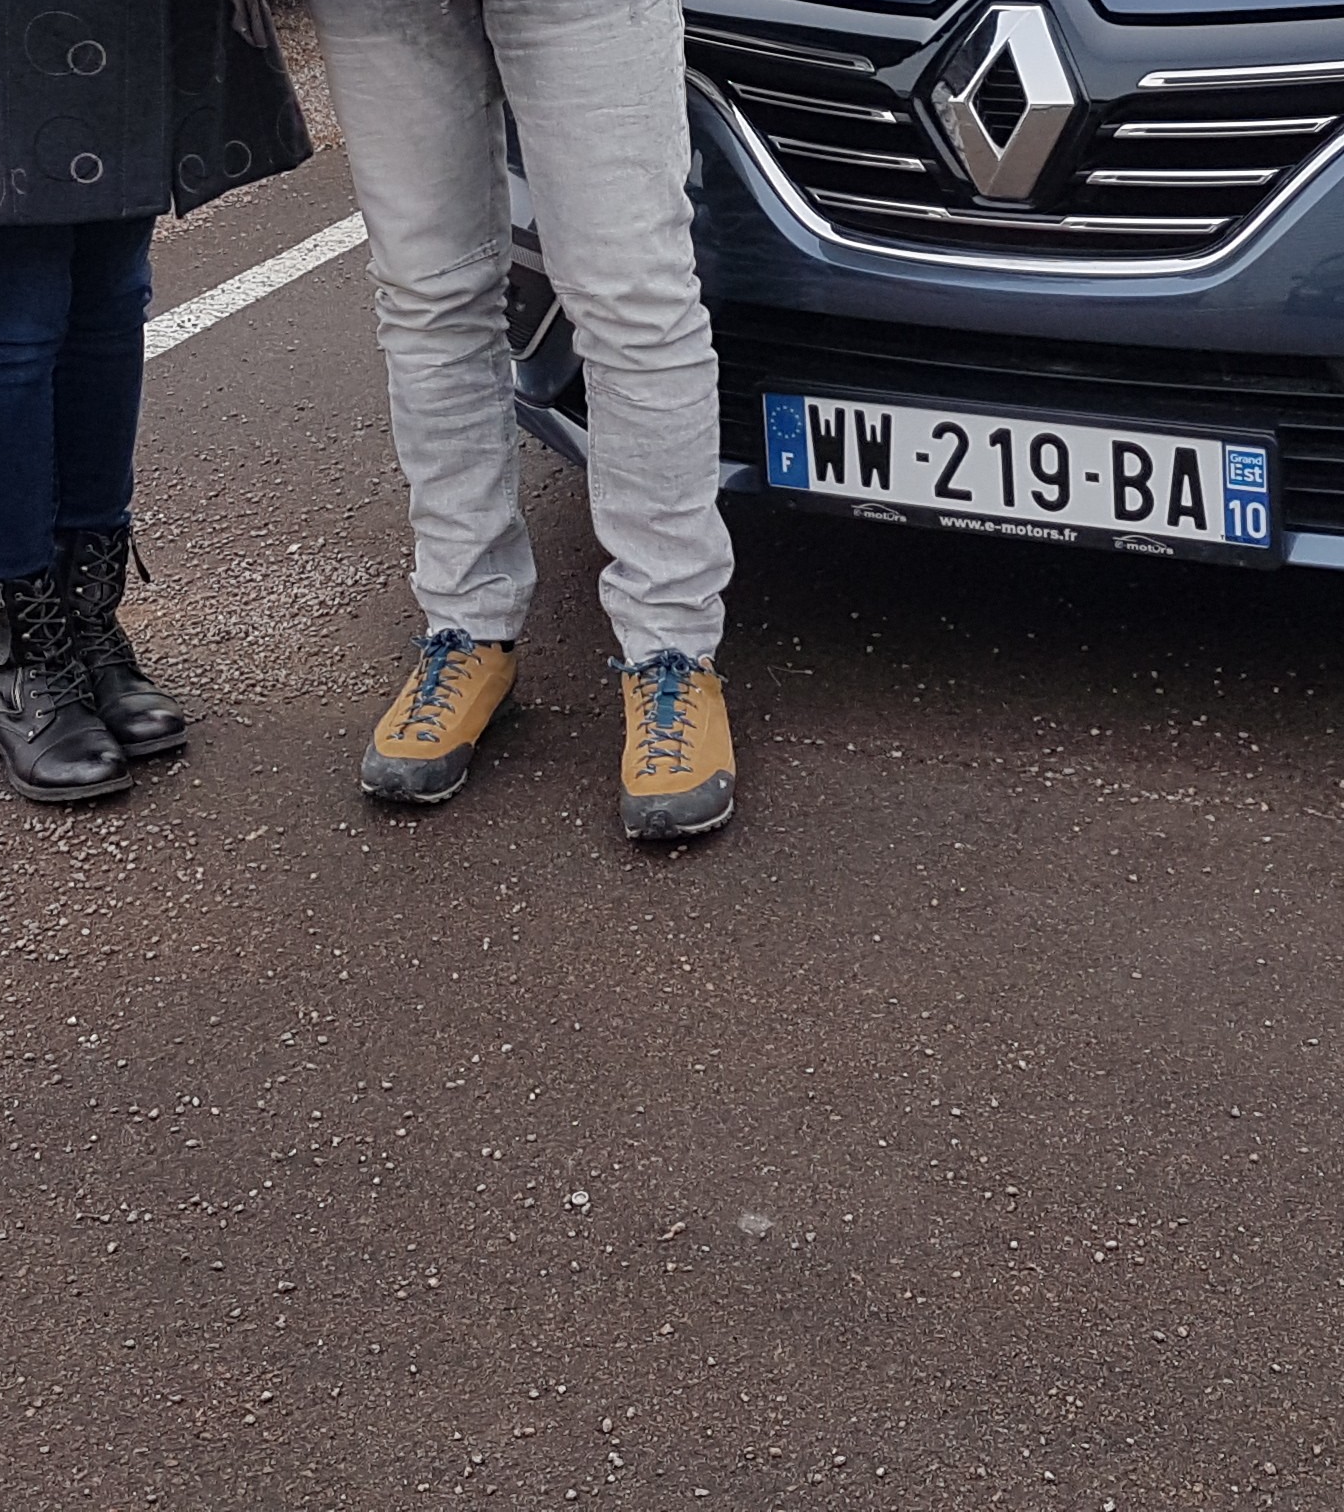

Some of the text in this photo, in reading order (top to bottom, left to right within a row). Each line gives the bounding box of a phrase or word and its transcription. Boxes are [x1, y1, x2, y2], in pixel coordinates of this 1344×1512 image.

[781, 451, 794, 473] F
[1230, 453, 1263, 466] Grand
[1230, 463, 1263, 483] Est
[940, 515, 1078, 542] www.e-motors.fr
[1229, 499, 1267, 539] 10
